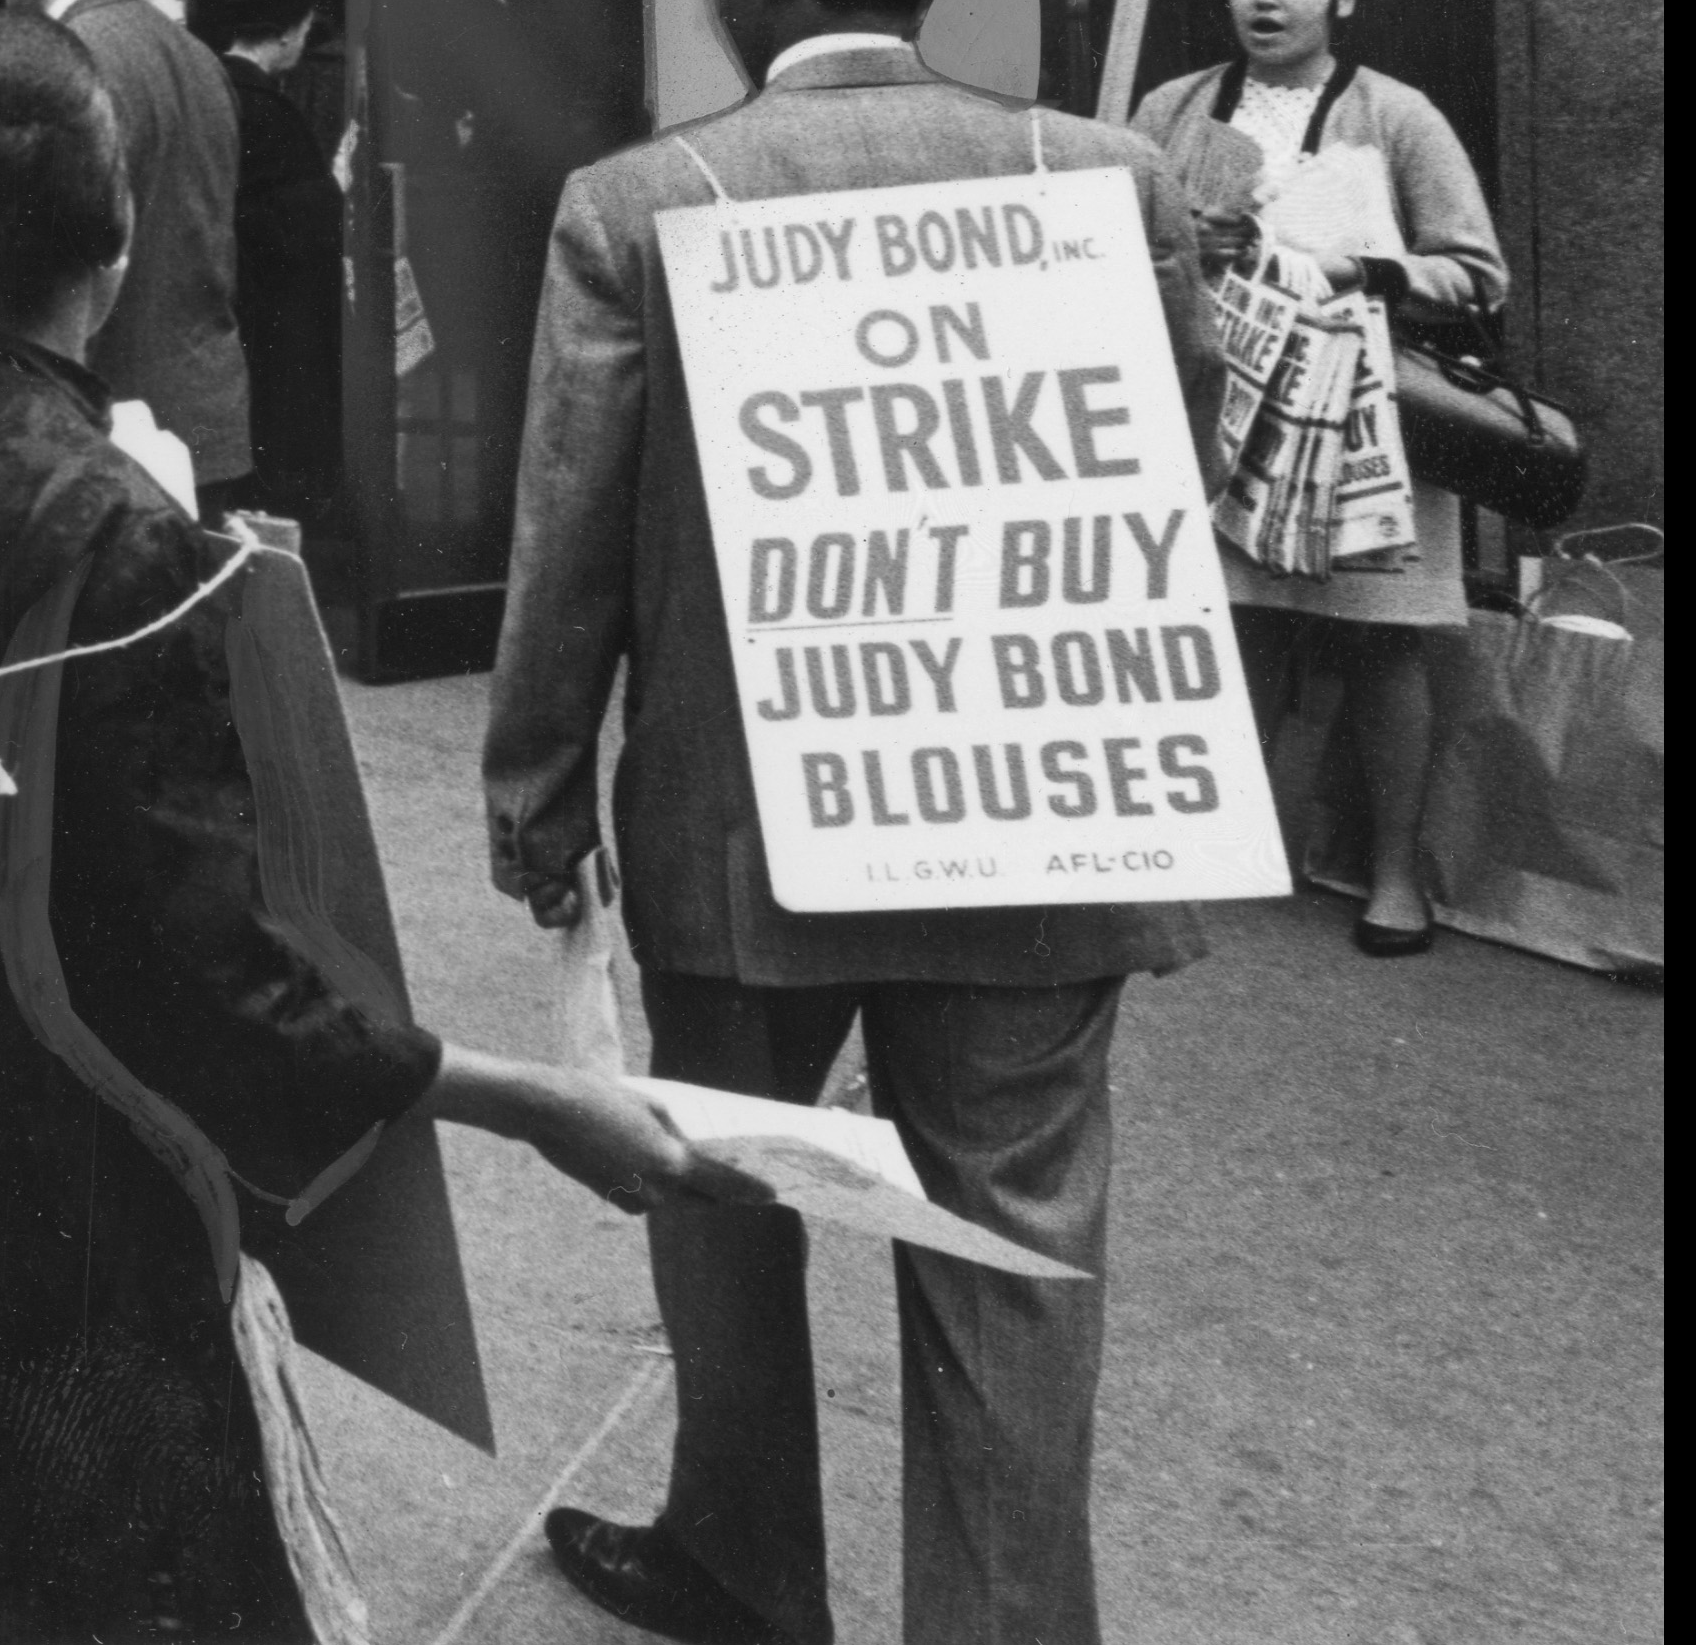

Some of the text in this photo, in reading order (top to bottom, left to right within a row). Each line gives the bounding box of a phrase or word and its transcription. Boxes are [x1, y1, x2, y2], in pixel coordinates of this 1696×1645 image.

[709, 203, 1108, 294] JUDY BOND, INC.
[855, 301, 992, 369] ON
[738, 364, 1141, 501] STRIKE
[747, 509, 1187, 624] DON'T BUY
[756, 623, 1221, 722] JUDY BOND
[800, 733, 1220, 829] BLOUSES
[1045, 849, 1174, 876] AFL-CIO
